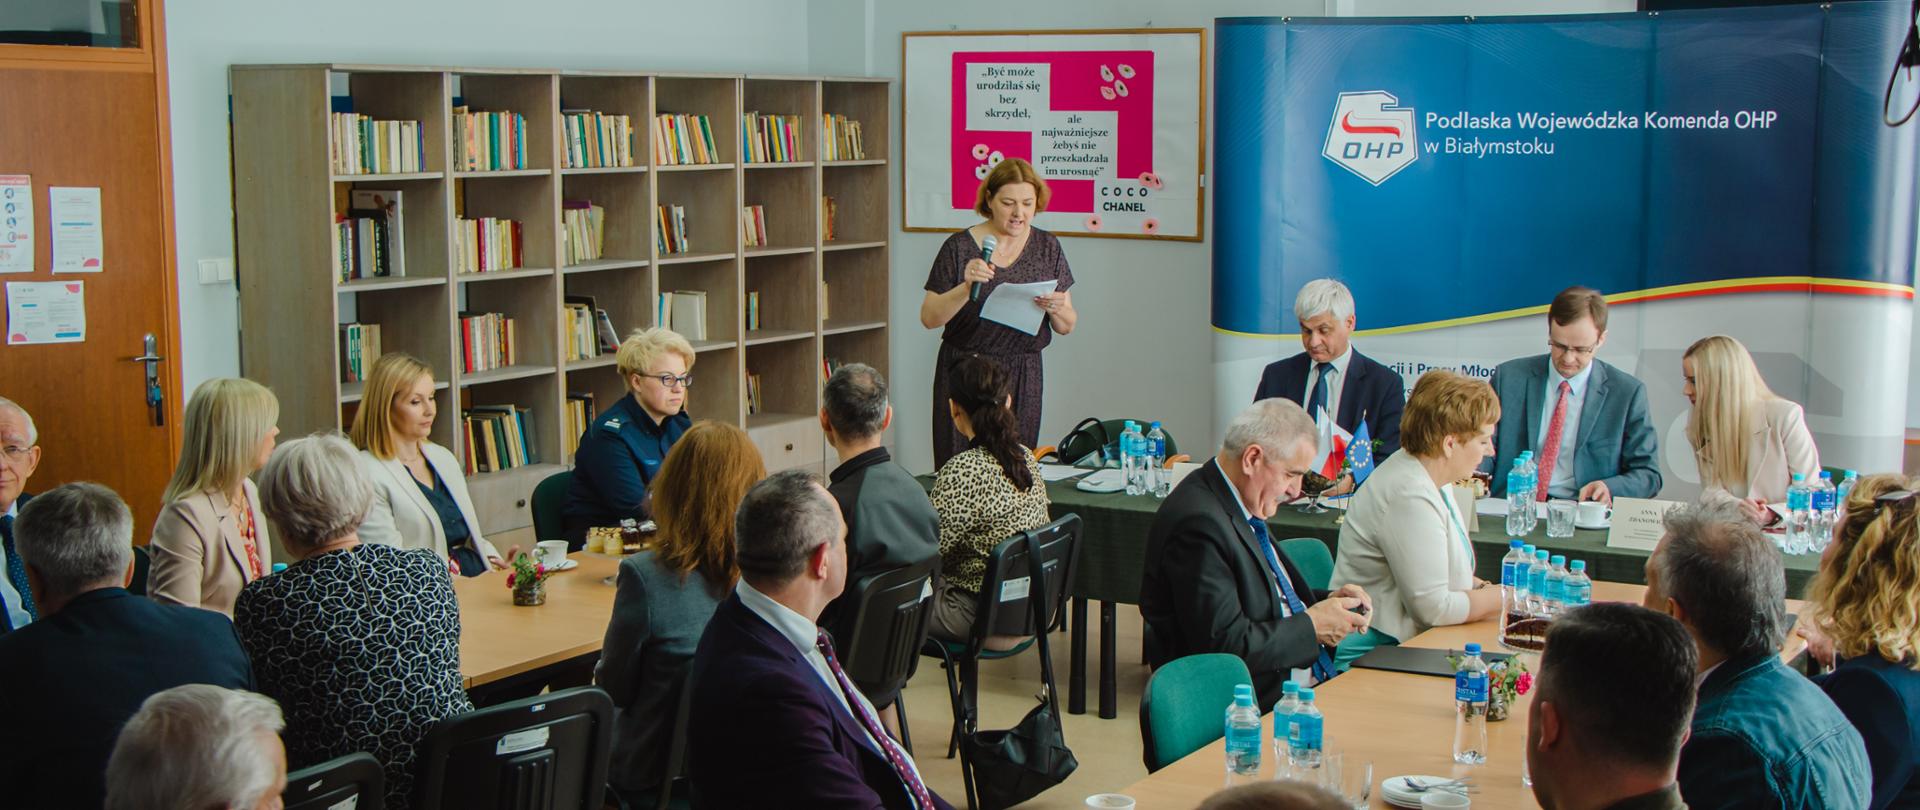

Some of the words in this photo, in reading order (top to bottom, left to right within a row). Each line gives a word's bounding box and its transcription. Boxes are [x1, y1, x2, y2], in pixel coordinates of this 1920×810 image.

[1007, 66, 1035, 77] może
[976, 80, 1024, 90] urodziłaś
[1025, 80, 1041, 92] się
[999, 94, 1017, 104] bez
[985, 107, 1031, 120] skrzydeł,
[1067, 114, 1082, 124] ale
[1425, 111, 1512, 129] Podlaska
[1517, 110, 1639, 133] Wojewódzka
[1644, 110, 1729, 129] Komenda
[1734, 110, 1778, 129] OHP
[1041, 127, 1109, 139] najważniejsze
[1052, 140, 1079, 152] żebyś
[1081, 140, 1097, 150] nie
[1342, 142, 1404, 159] OHP
[1424, 141, 1440, 153] w
[1445, 136, 1555, 159] Białymstoku
[1040, 153, 1109, 165] przeszkadzała
[1045, 165, 1058, 175] im
[1102, 201, 1146, 212] CHANEL
[1408, 362, 1413, 375] i
